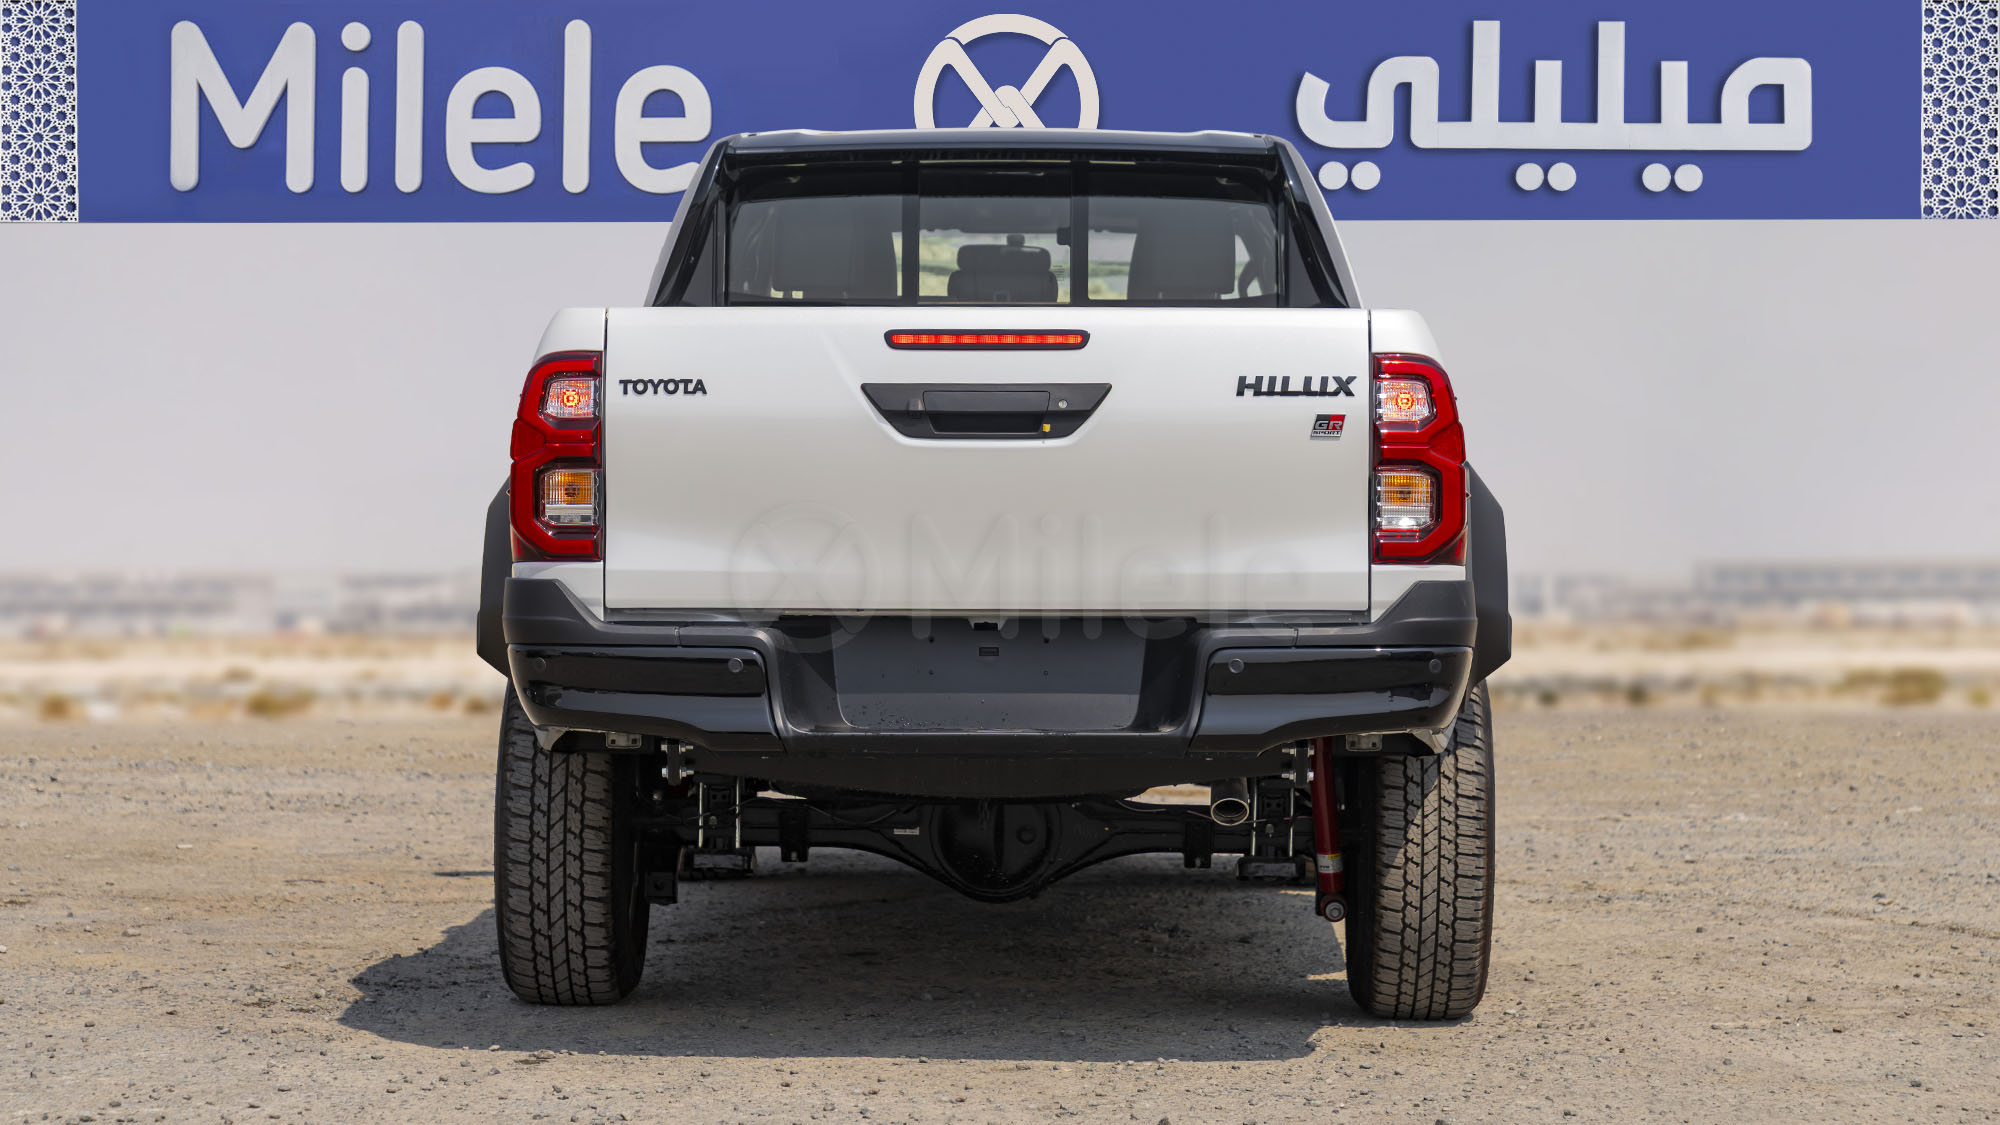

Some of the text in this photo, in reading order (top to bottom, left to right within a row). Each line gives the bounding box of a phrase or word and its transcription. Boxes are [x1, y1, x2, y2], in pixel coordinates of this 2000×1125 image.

[170, 19, 712, 194] Milele
[1296, 20, 1812, 192] ميليلي
[619, 379, 707, 395] TOYOTA
[1236, 376, 1357, 397] HILUX
[1314, 420, 1343, 430] GR
